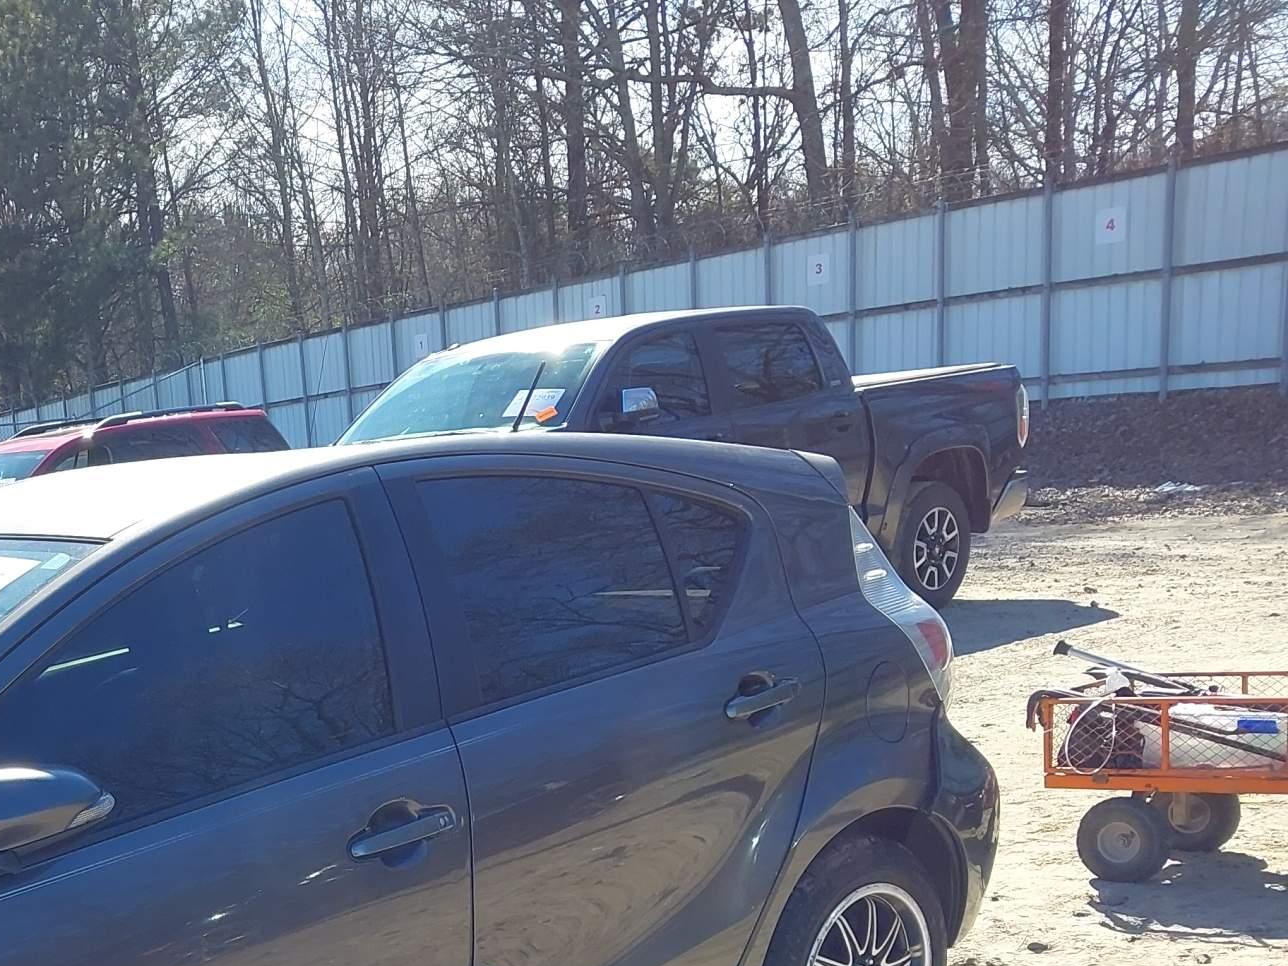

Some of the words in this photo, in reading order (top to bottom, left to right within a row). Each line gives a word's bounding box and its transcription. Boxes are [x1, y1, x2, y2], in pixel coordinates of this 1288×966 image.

[1105, 217, 1116, 231] 4
[815, 262, 824, 275] 3
[594, 304, 601, 315] 2
